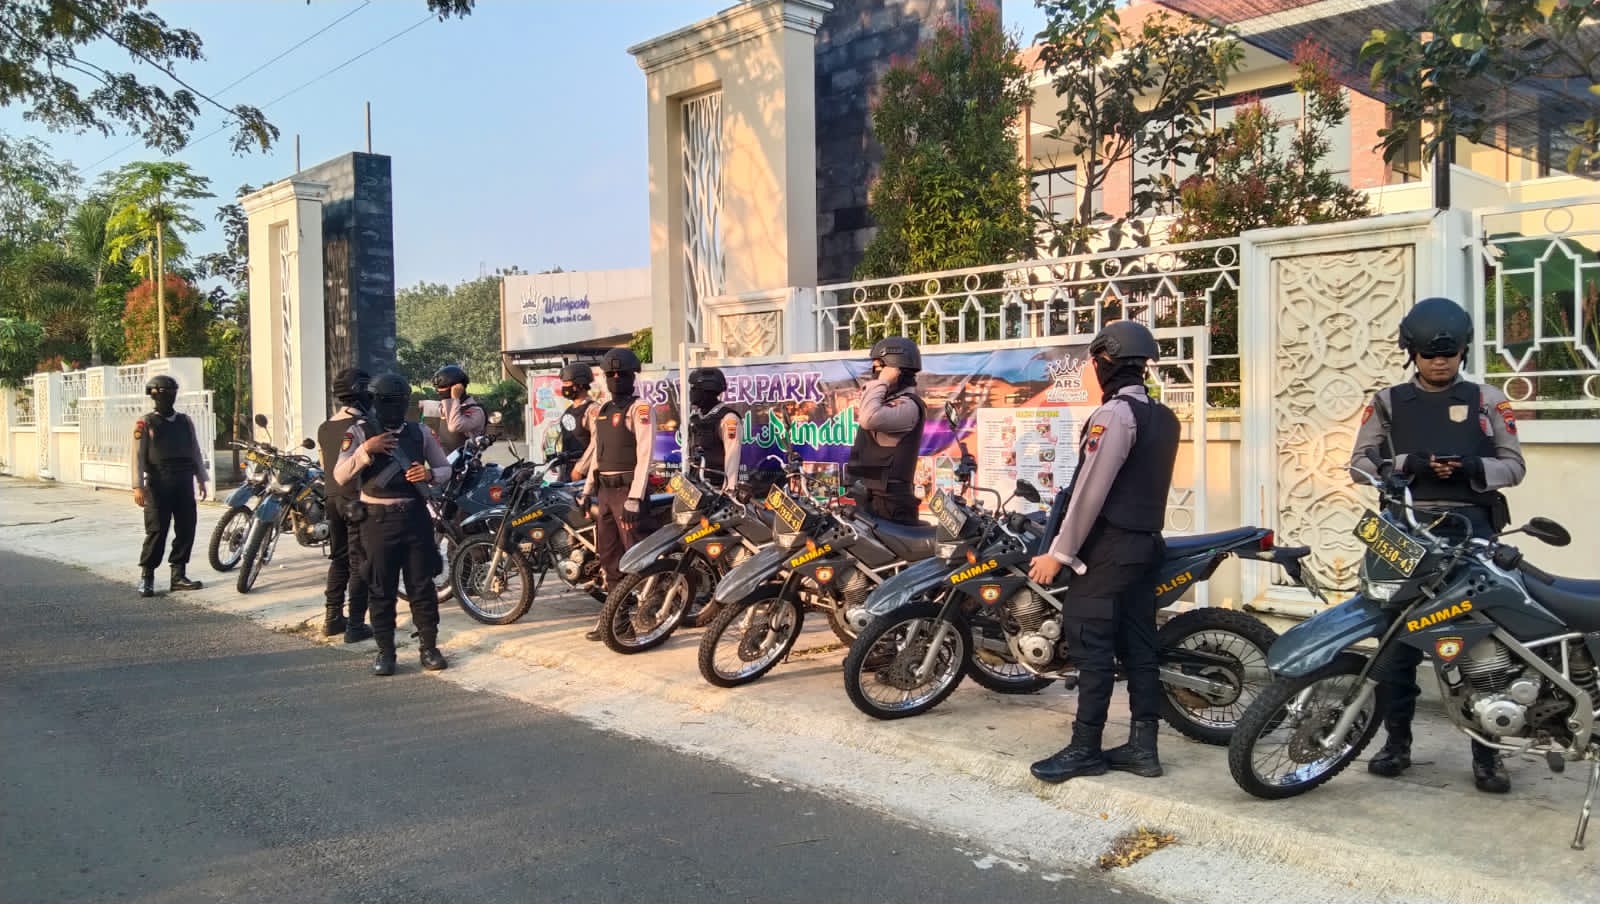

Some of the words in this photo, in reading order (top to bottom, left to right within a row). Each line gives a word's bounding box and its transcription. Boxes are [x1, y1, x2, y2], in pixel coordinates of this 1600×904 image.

[522, 314, 537, 325] ARS
[632, 371, 670, 406] ARS
[1055, 379, 1081, 389] ARS
[757, 404, 860, 452] Ramadh
[511, 509, 543, 527] RAIMAS
[684, 522, 721, 543] RAIMAS
[791, 543, 832, 567] RAIMAS
[1376, 539, 1415, 574] 1530-43
[950, 559, 998, 584] RAIMAS
[1155, 571, 1193, 597] OLISI
[1407, 600, 1473, 632] RAIMAS
